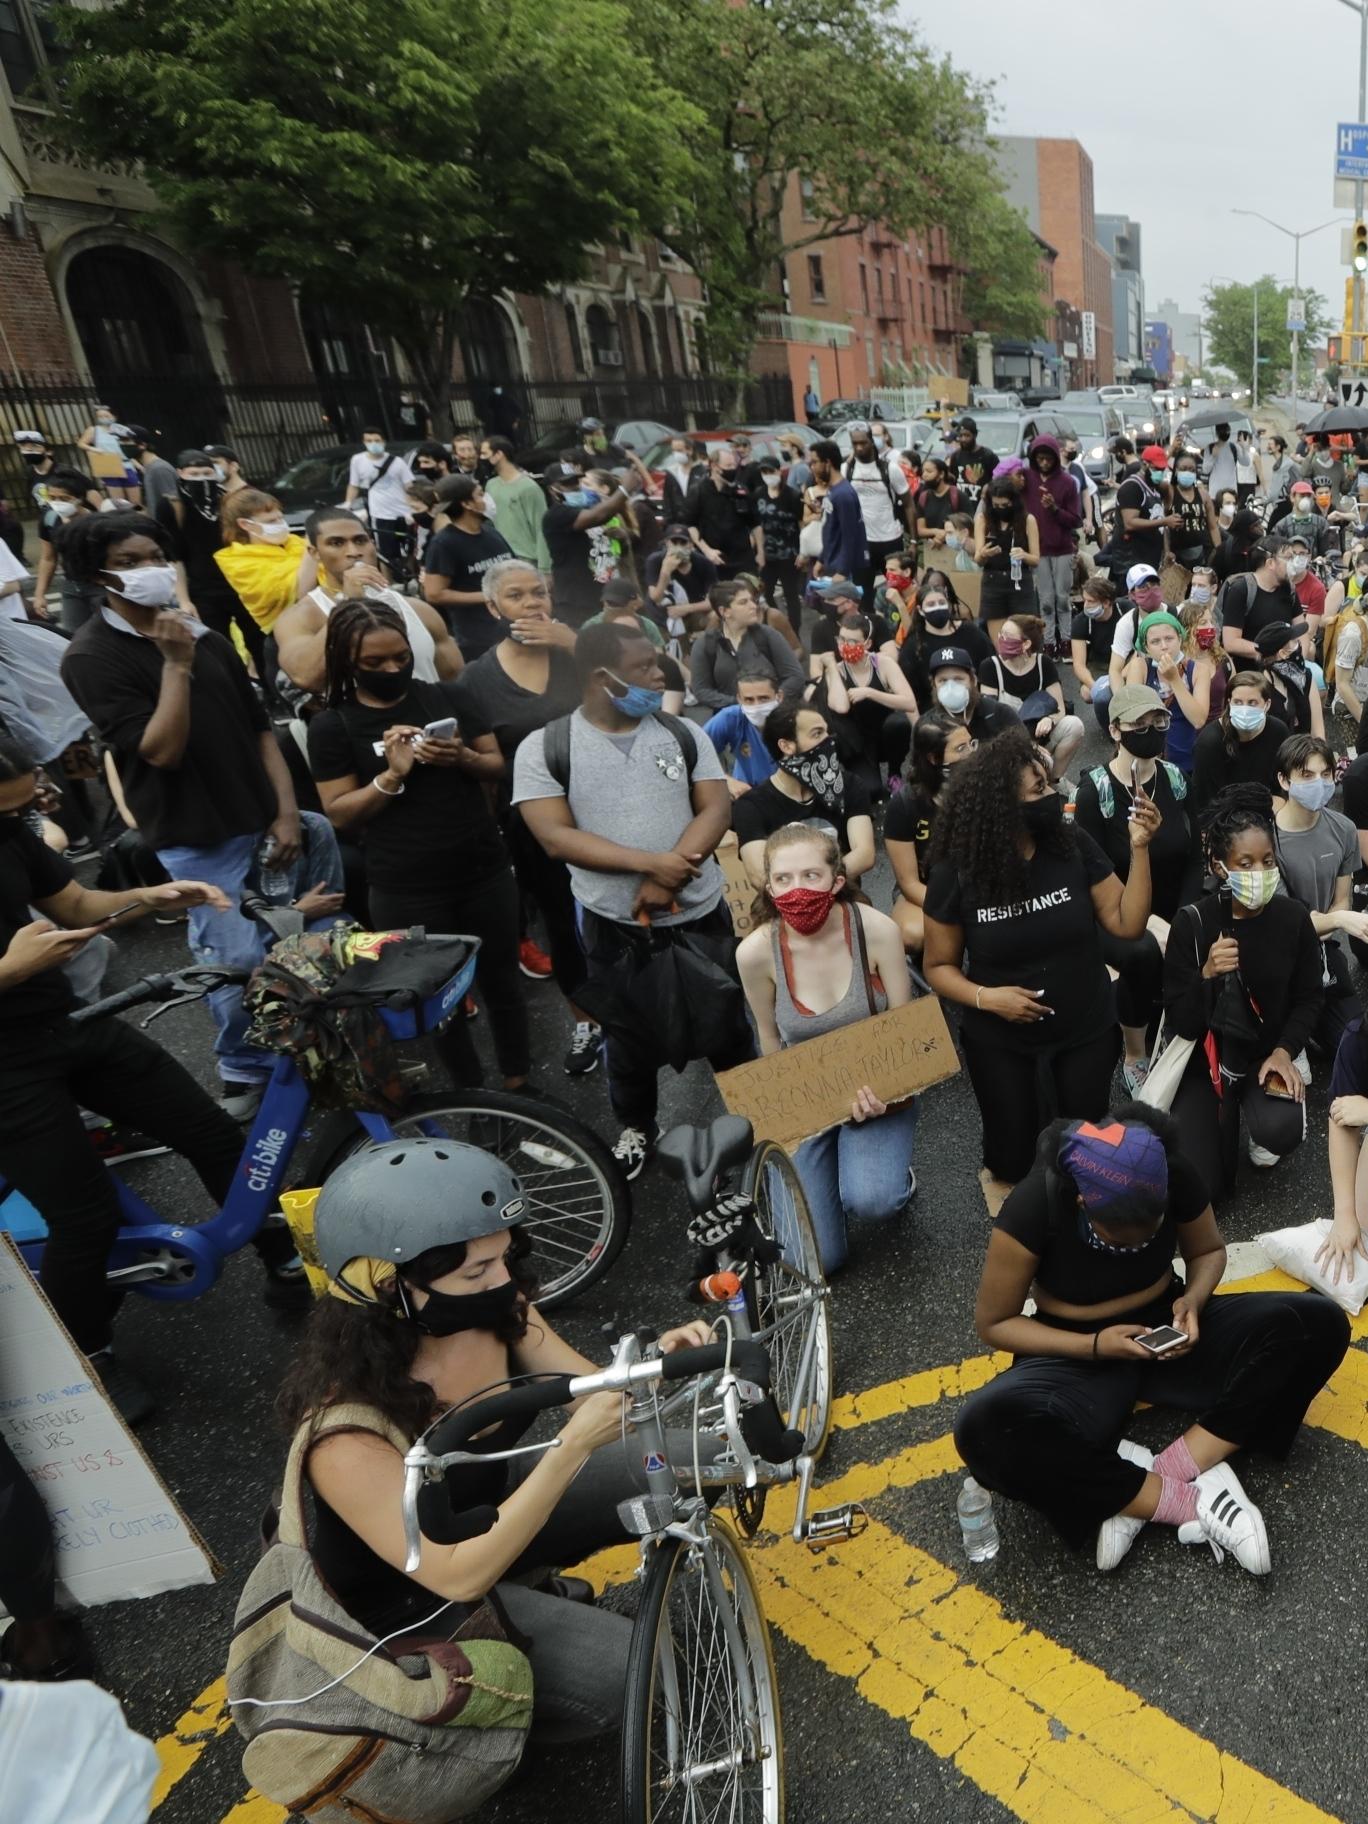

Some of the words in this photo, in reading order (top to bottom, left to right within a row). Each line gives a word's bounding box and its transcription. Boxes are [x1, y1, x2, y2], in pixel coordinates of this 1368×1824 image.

[976, 887, 1072, 923] RESISTANCE
[873, 1016, 907, 1039] FOR
[856, 1037, 924, 1081] TAYLOR
[1070, 1149, 1098, 1174] CALVIN
[1098, 1167, 1130, 1187] KLEIN
[8, 1408, 86, 1435] EXISTENCE
[71, 1453, 101, 1473] US
[109, 1512, 180, 1540] CLOTHED
